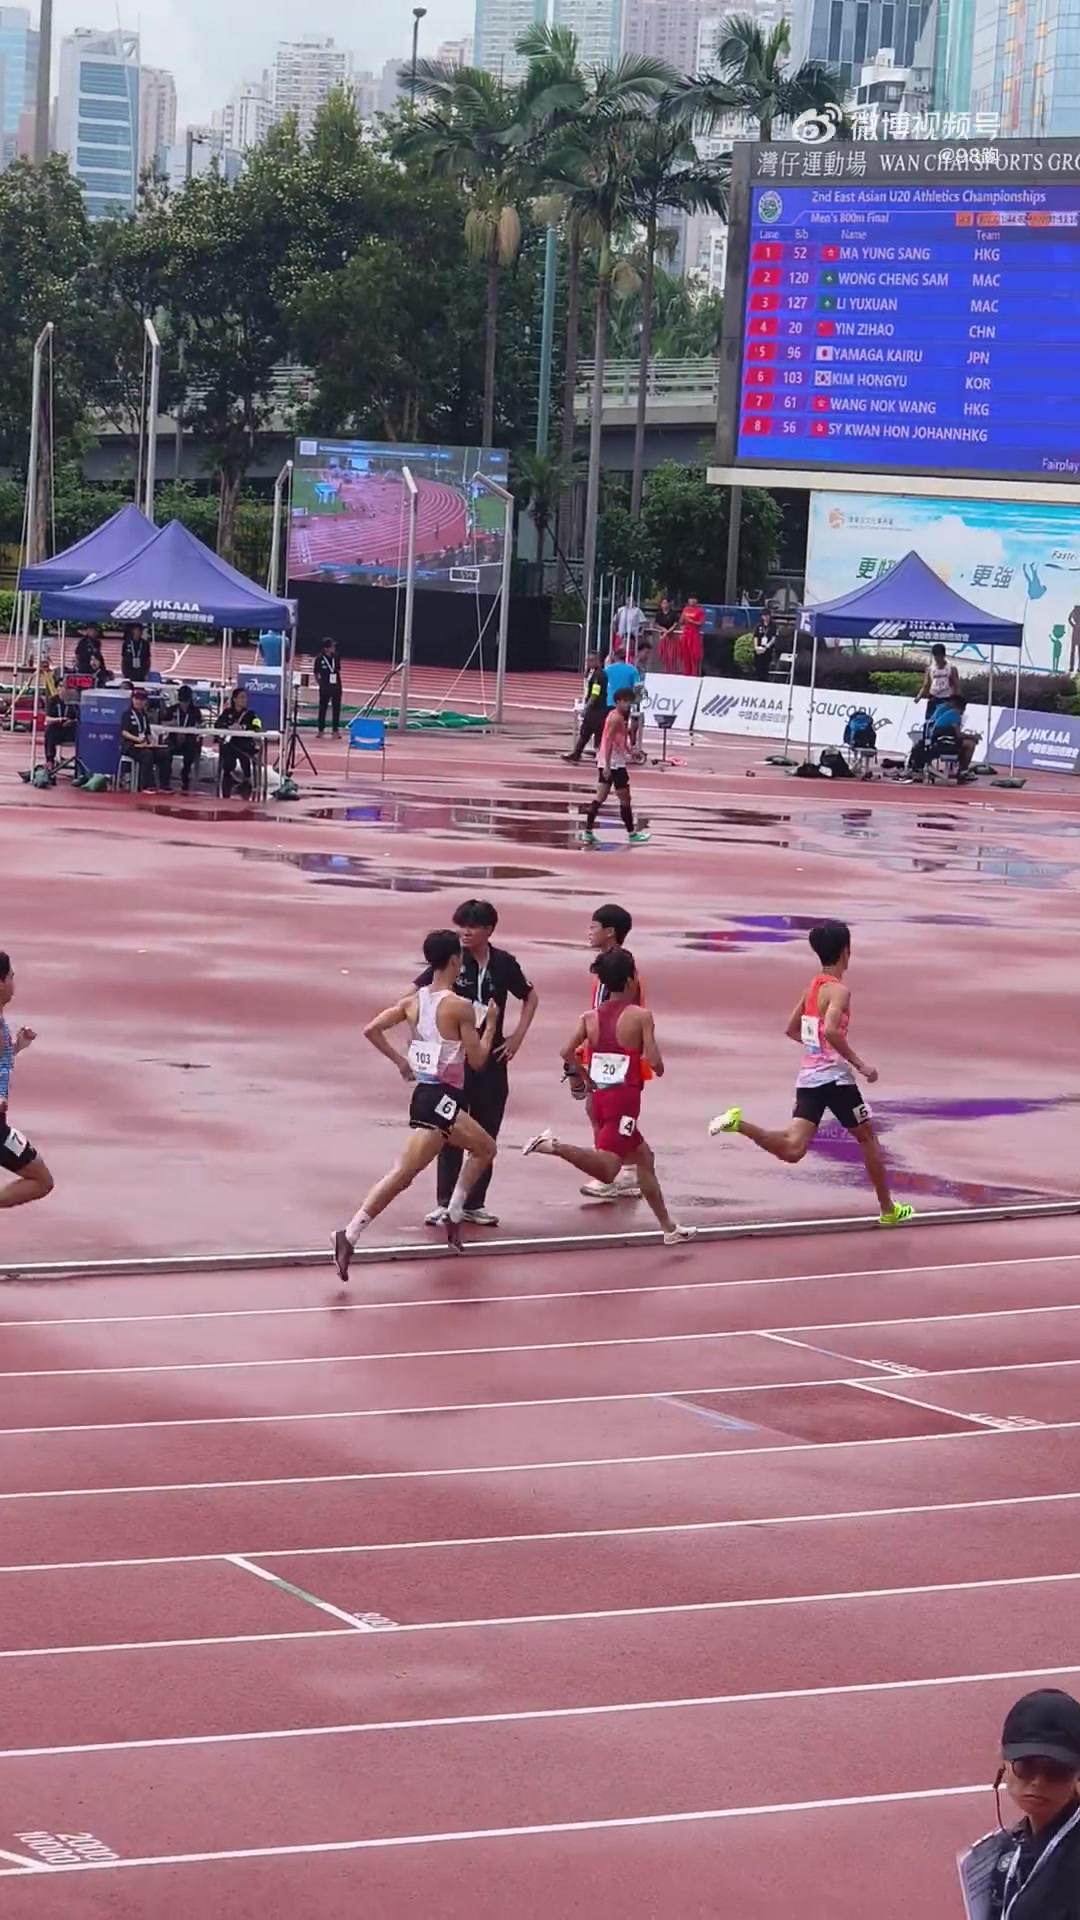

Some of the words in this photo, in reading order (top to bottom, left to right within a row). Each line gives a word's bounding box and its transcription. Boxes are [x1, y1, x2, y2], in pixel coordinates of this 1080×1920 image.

[757, 151, 867, 177] 灣仔運動場
[879, 154, 920, 171] WAN
[974, 153, 1043, 171] SPORTS
[812, 190, 831, 203] 2nd
[834, 191, 856, 203] East
[859, 190, 886, 203] Asian
[889, 190, 910, 203] U20
[913, 189, 959, 203] Athletics
[962, 189, 1046, 206] Championships
[810, 212, 838, 223] Men's
[840, 213, 865, 223] 800m
[867, 213, 889, 223] Final
[759, 230, 779, 239] Lane
[841, 230, 867, 240] Name
[976, 230, 1000, 241] Team
[766, 247, 771, 258] 1
[794, 247, 807, 259] 52
[840, 247, 858, 259] MA
[862, 248, 894, 260] YUNG
[898, 248, 931, 260] SANG
[974, 248, 1000, 261] HKG
[763, 272, 770, 283] 2
[789, 272, 809, 284] 120
[838, 272, 875, 285] WONG
[879, 273, 918, 286] CHENG
[922, 273, 949, 286] SAM
[972, 274, 1001, 287] MAC
[762, 297, 769, 308] 3
[788, 296, 808, 308] 127
[837, 298, 846, 309] LI
[850, 298, 897, 310] YUXUAN
[970, 299, 999, 312] MAC
[760, 321, 767, 333] 4
[788, 322, 803, 334] 20
[835, 323, 854, 336] YIN
[857, 323, 894, 336] ZIHAO
[969, 325, 996, 338] CHN
[759, 346, 765, 357] 5
[787, 346, 801, 359] 96
[833, 348, 884, 361] YAMAGA
[887, 349, 923, 362] KAIRU
[966, 351, 990, 364] JPN
[757, 371, 764, 382] 6
[783, 371, 803, 384] 103
[831, 374, 854, 386] KIM
[857, 375, 907, 387] HONGYU
[965, 377, 991, 390] KOR
[756, 396, 763, 407] 7
[784, 396, 796, 408] 61
[830, 398, 867, 411] WANG
[870, 399, 895, 412] NOK
[898, 400, 936, 414] WANG
[964, 402, 990, 416] HKG
[754, 420, 761, 431] 8
[783, 421, 796, 433] 56
[828, 423, 842, 435] SY
[845, 423, 880, 437] KWAN
[883, 425, 910, 438] HON
[153, 600, 200, 612] HKAAA
[910, 620, 955, 631] HKAAA
[741, 696, 784, 711] HKAAA
[1031, 728, 1071, 744] HKAAA
[415, 1051, 431, 1065] 103
[602, 1063, 616, 1076] 20
[443, 1101, 452, 1114] 6
[859, 1106, 868, 1118] 5
[624, 1119, 633, 1133] 4
[12, 1132, 24, 1145] 7
[12, 1831, 81, 1863] 10000
[55, 1832, 120, 1860] 2000
